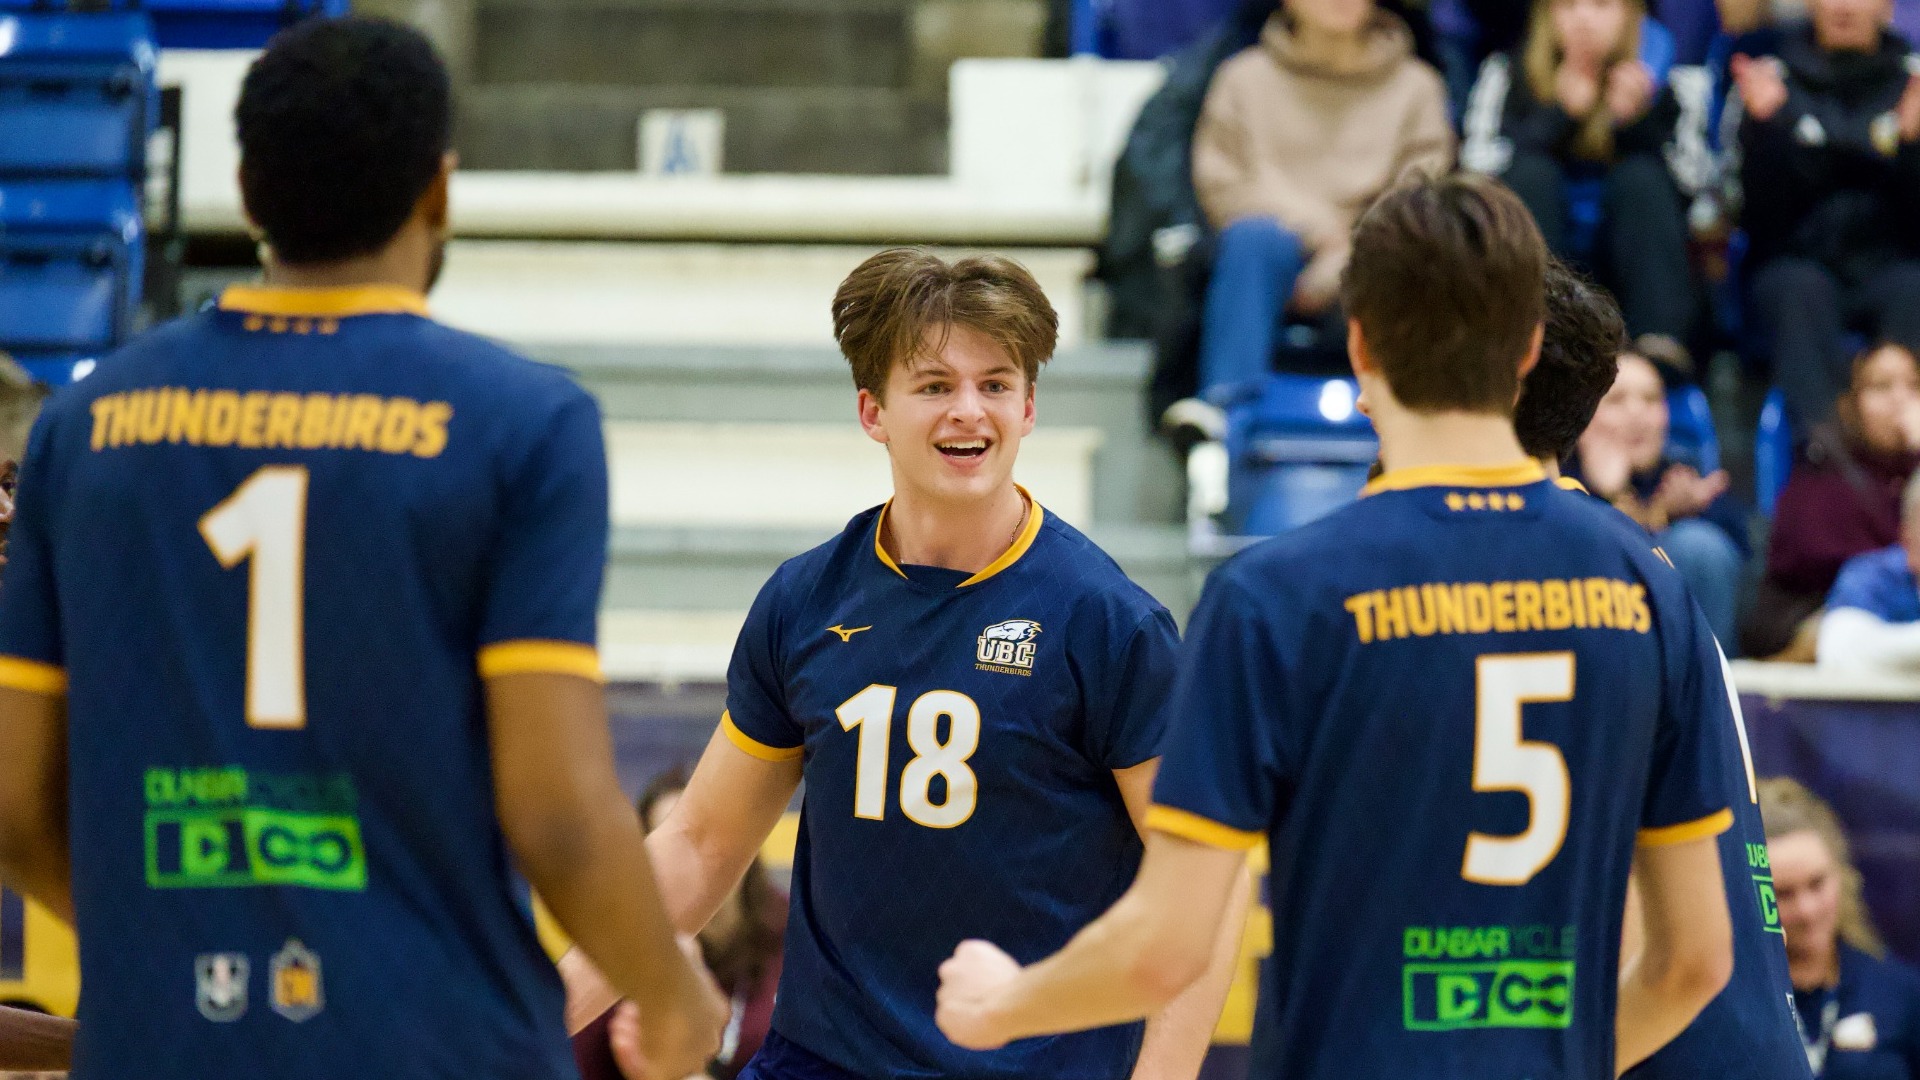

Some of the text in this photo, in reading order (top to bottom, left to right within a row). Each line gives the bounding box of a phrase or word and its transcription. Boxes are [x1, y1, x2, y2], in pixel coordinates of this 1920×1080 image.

[90, 386, 454, 458] THUNDERBIRDS
[198, 464, 309, 730] 1
[1345, 576, 1653, 644] THUNDERBIRDS
[975, 663, 1032, 677] THUNDERBIRDS
[976, 635, 1037, 669] UBC
[835, 683, 981, 829] 18
[1460, 650, 1577, 887] 5
